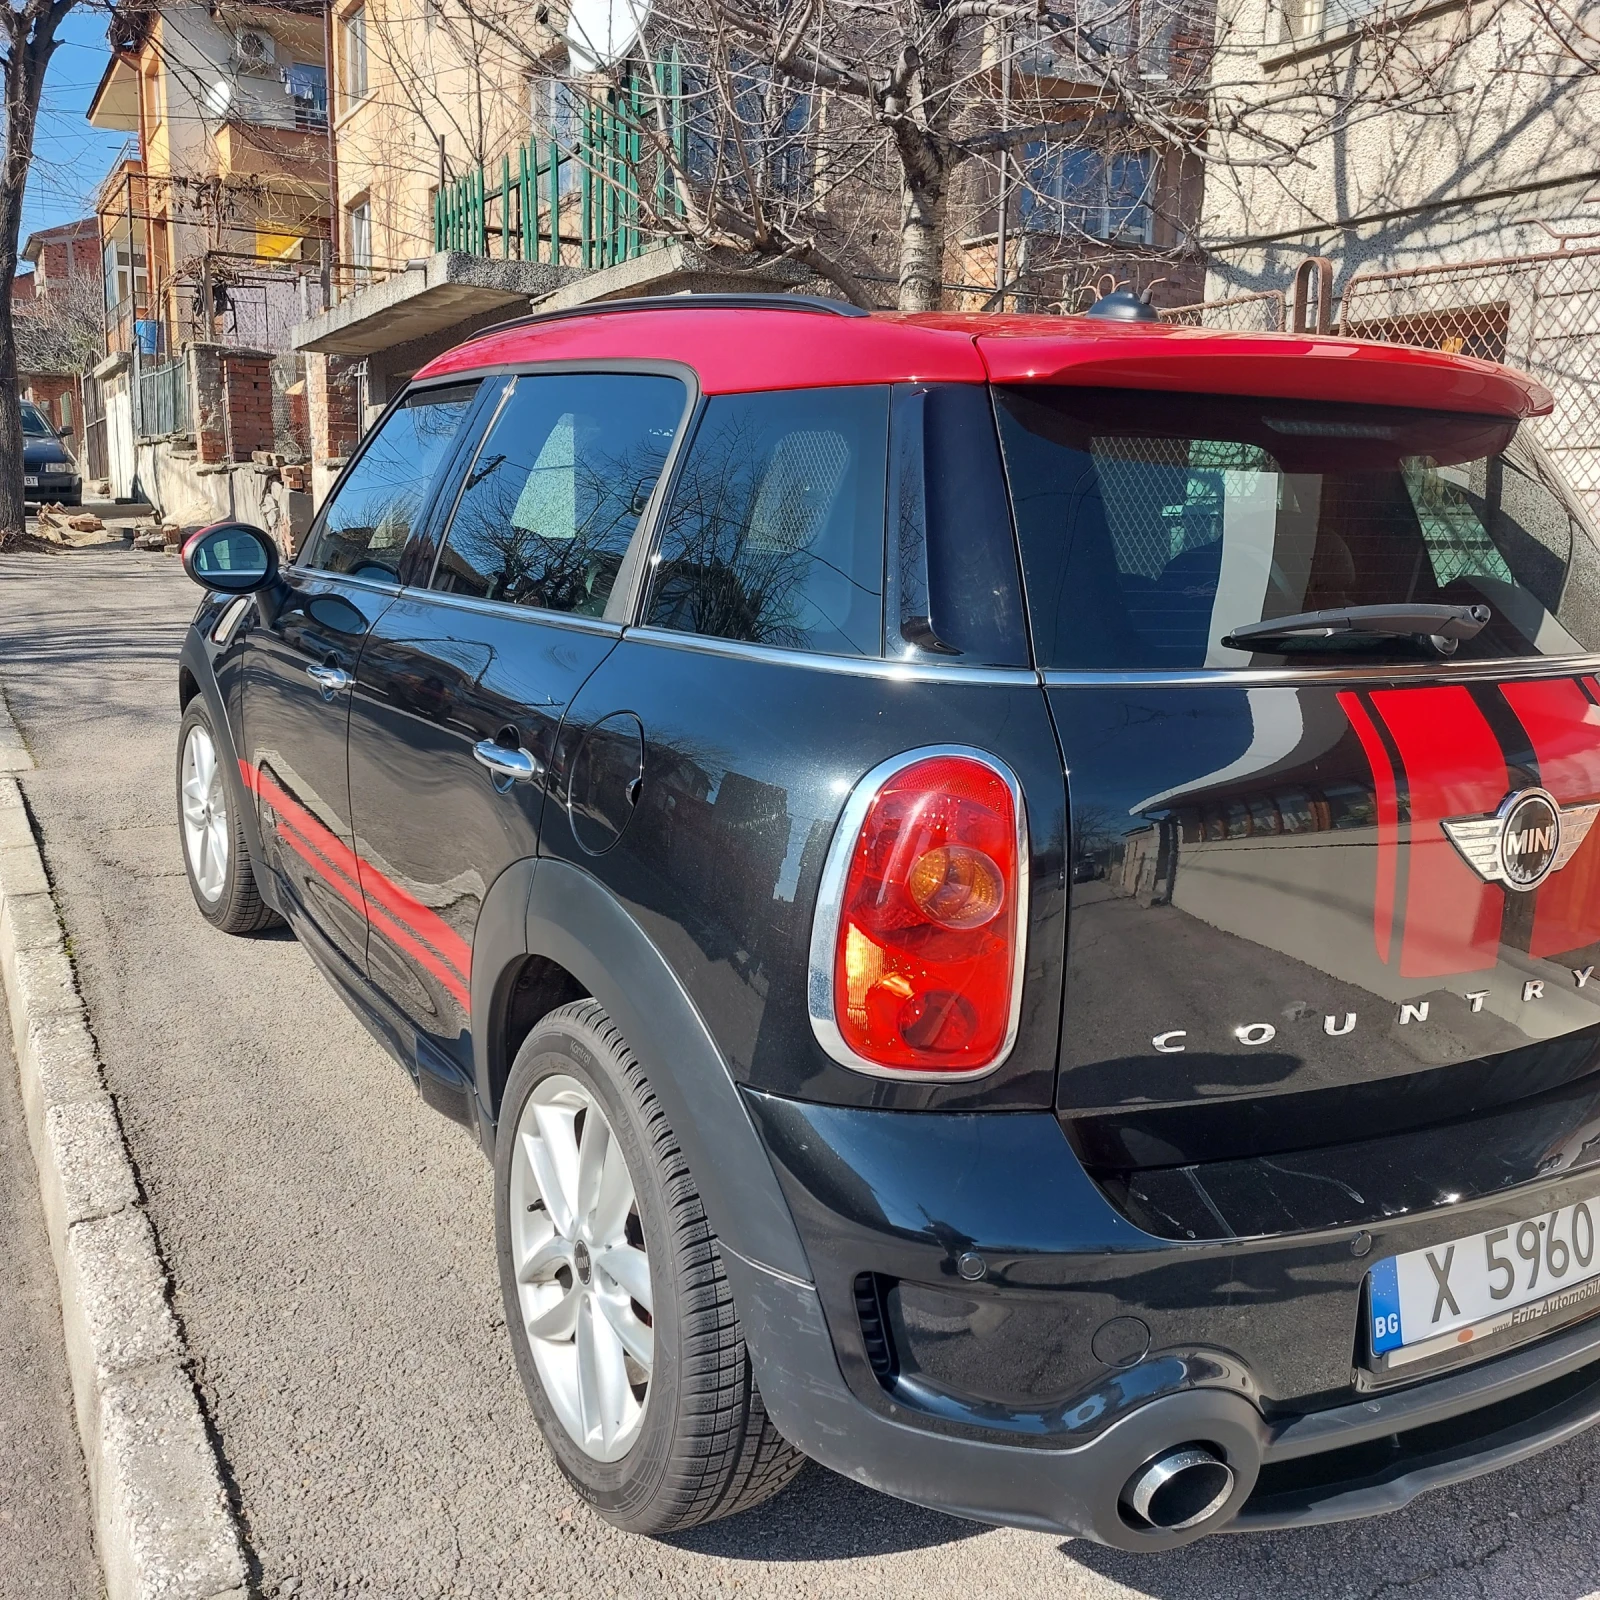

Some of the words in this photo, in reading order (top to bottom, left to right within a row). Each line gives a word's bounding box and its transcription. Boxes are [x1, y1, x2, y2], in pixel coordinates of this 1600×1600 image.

[1507, 824, 1554, 856] MINI
[1151, 964, 1595, 1053] COUNTRY
[569, 1040, 592, 1065] Kontrol
[1426, 1246, 1461, 1323] X
[1485, 1202, 1595, 1300] 5960
[1375, 1313, 1399, 1338] BG
